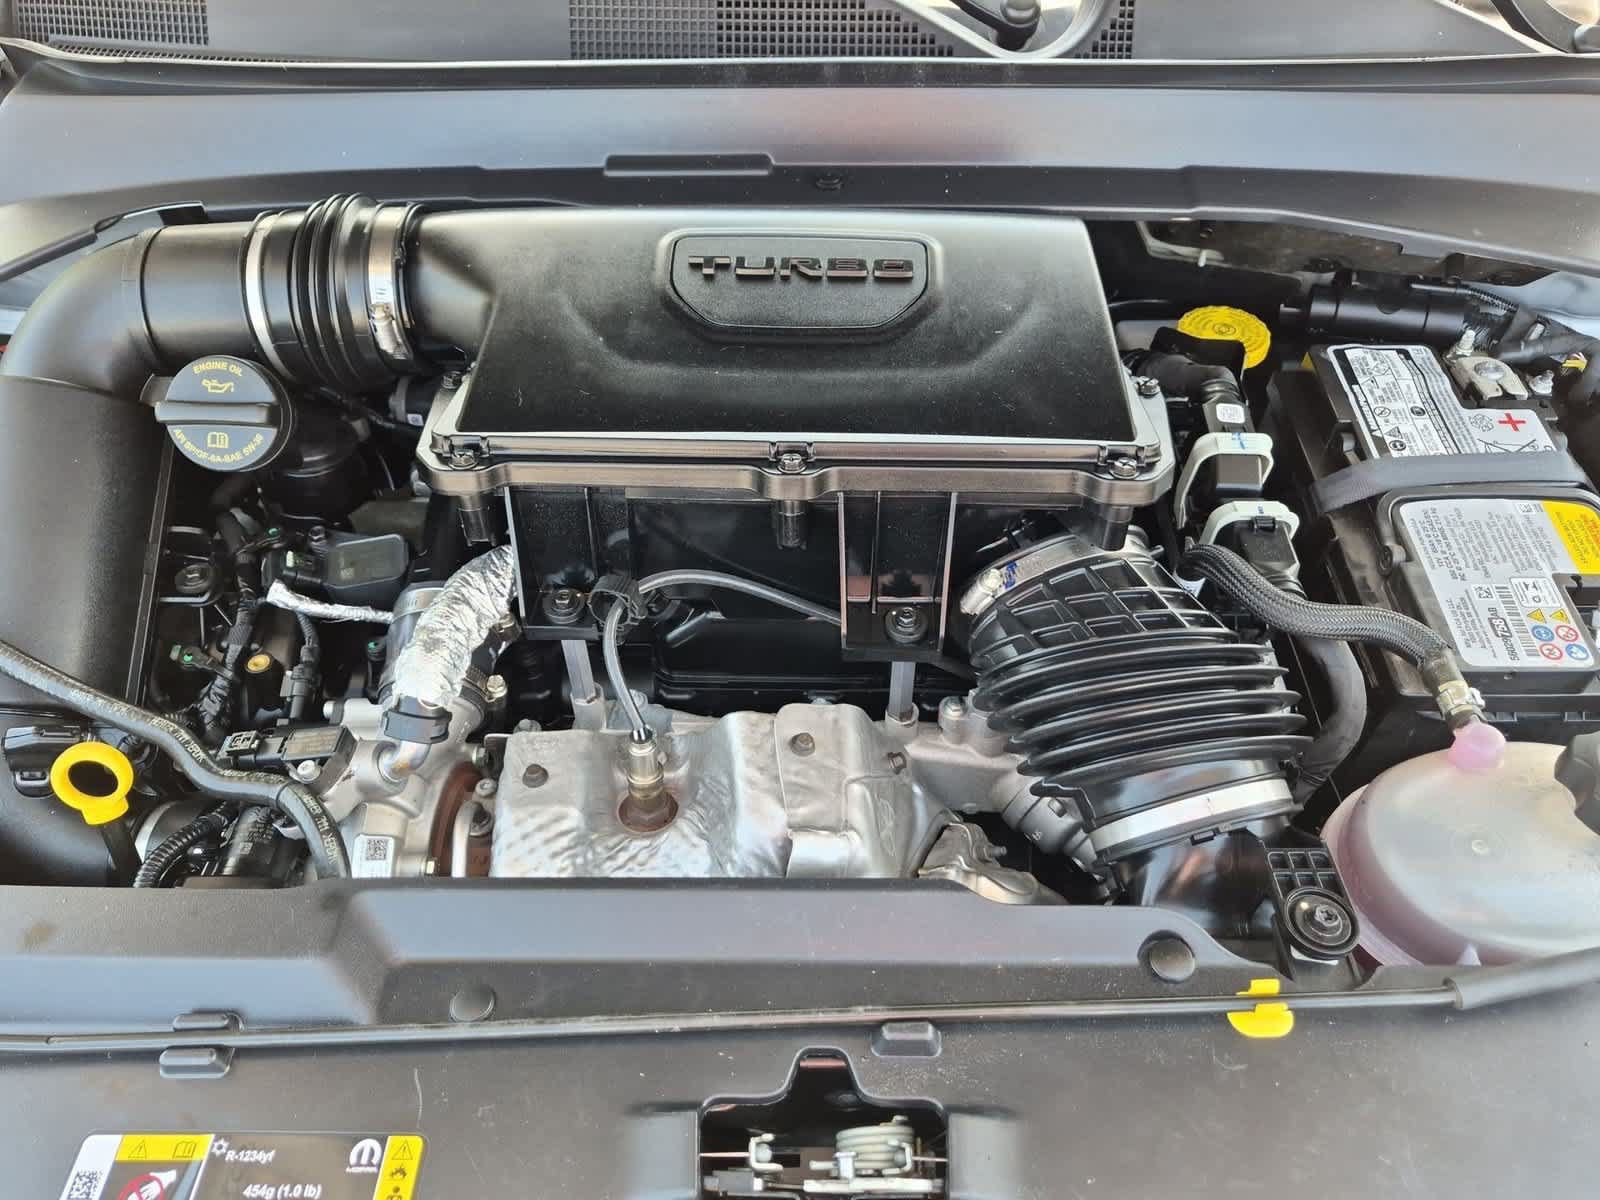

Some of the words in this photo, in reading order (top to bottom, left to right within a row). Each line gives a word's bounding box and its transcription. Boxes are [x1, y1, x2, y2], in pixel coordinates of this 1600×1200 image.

[688, 255, 914, 280] TURBO
[193, 361, 228, 374] ENGINE
[229, 363, 243, 377] OIL
[225, 1150, 276, 1164] R-1234yf
[243, 1184, 277, 1200] 454g
[277, 1184, 302, 1199] (1.0
[303, 1184, 322, 1199] lb)
